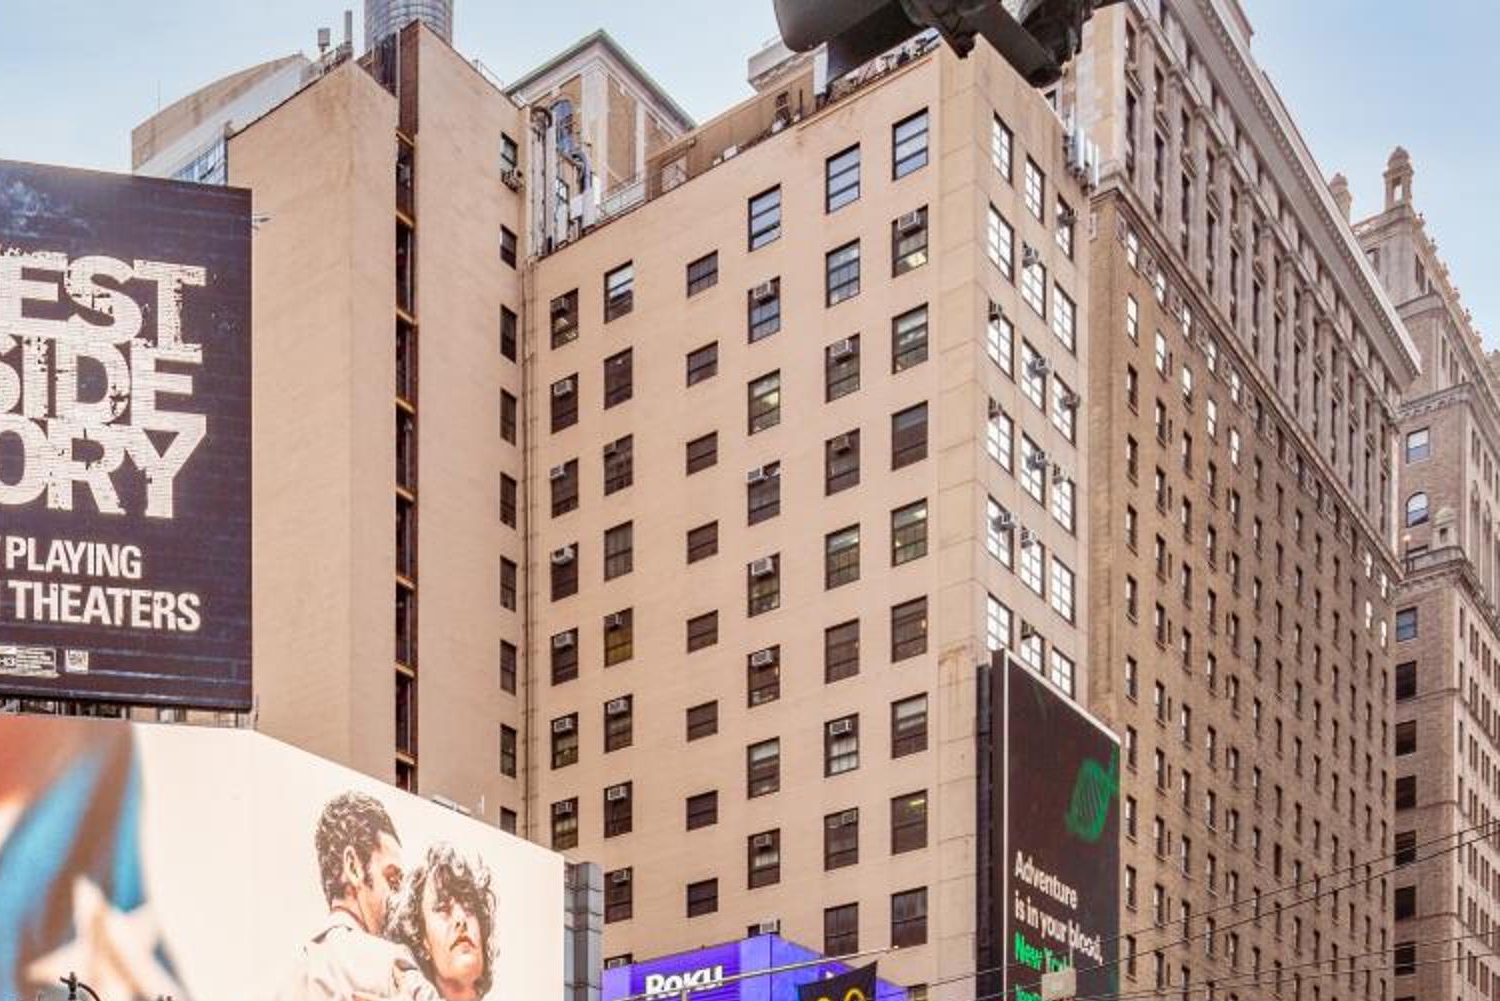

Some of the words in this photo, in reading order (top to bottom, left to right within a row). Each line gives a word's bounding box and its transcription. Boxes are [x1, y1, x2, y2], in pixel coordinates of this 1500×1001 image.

[5, 536, 143, 579] PLAYING
[7, 579, 201, 632] THEATERS
[1014, 850, 1077, 910] Adventure
[1014, 930, 1042, 972] New
[1015, 889, 1025, 923] is
[1027, 896, 1039, 929] in
[1040, 910, 1067, 943] your
[1068, 918, 1105, 968] blood,
